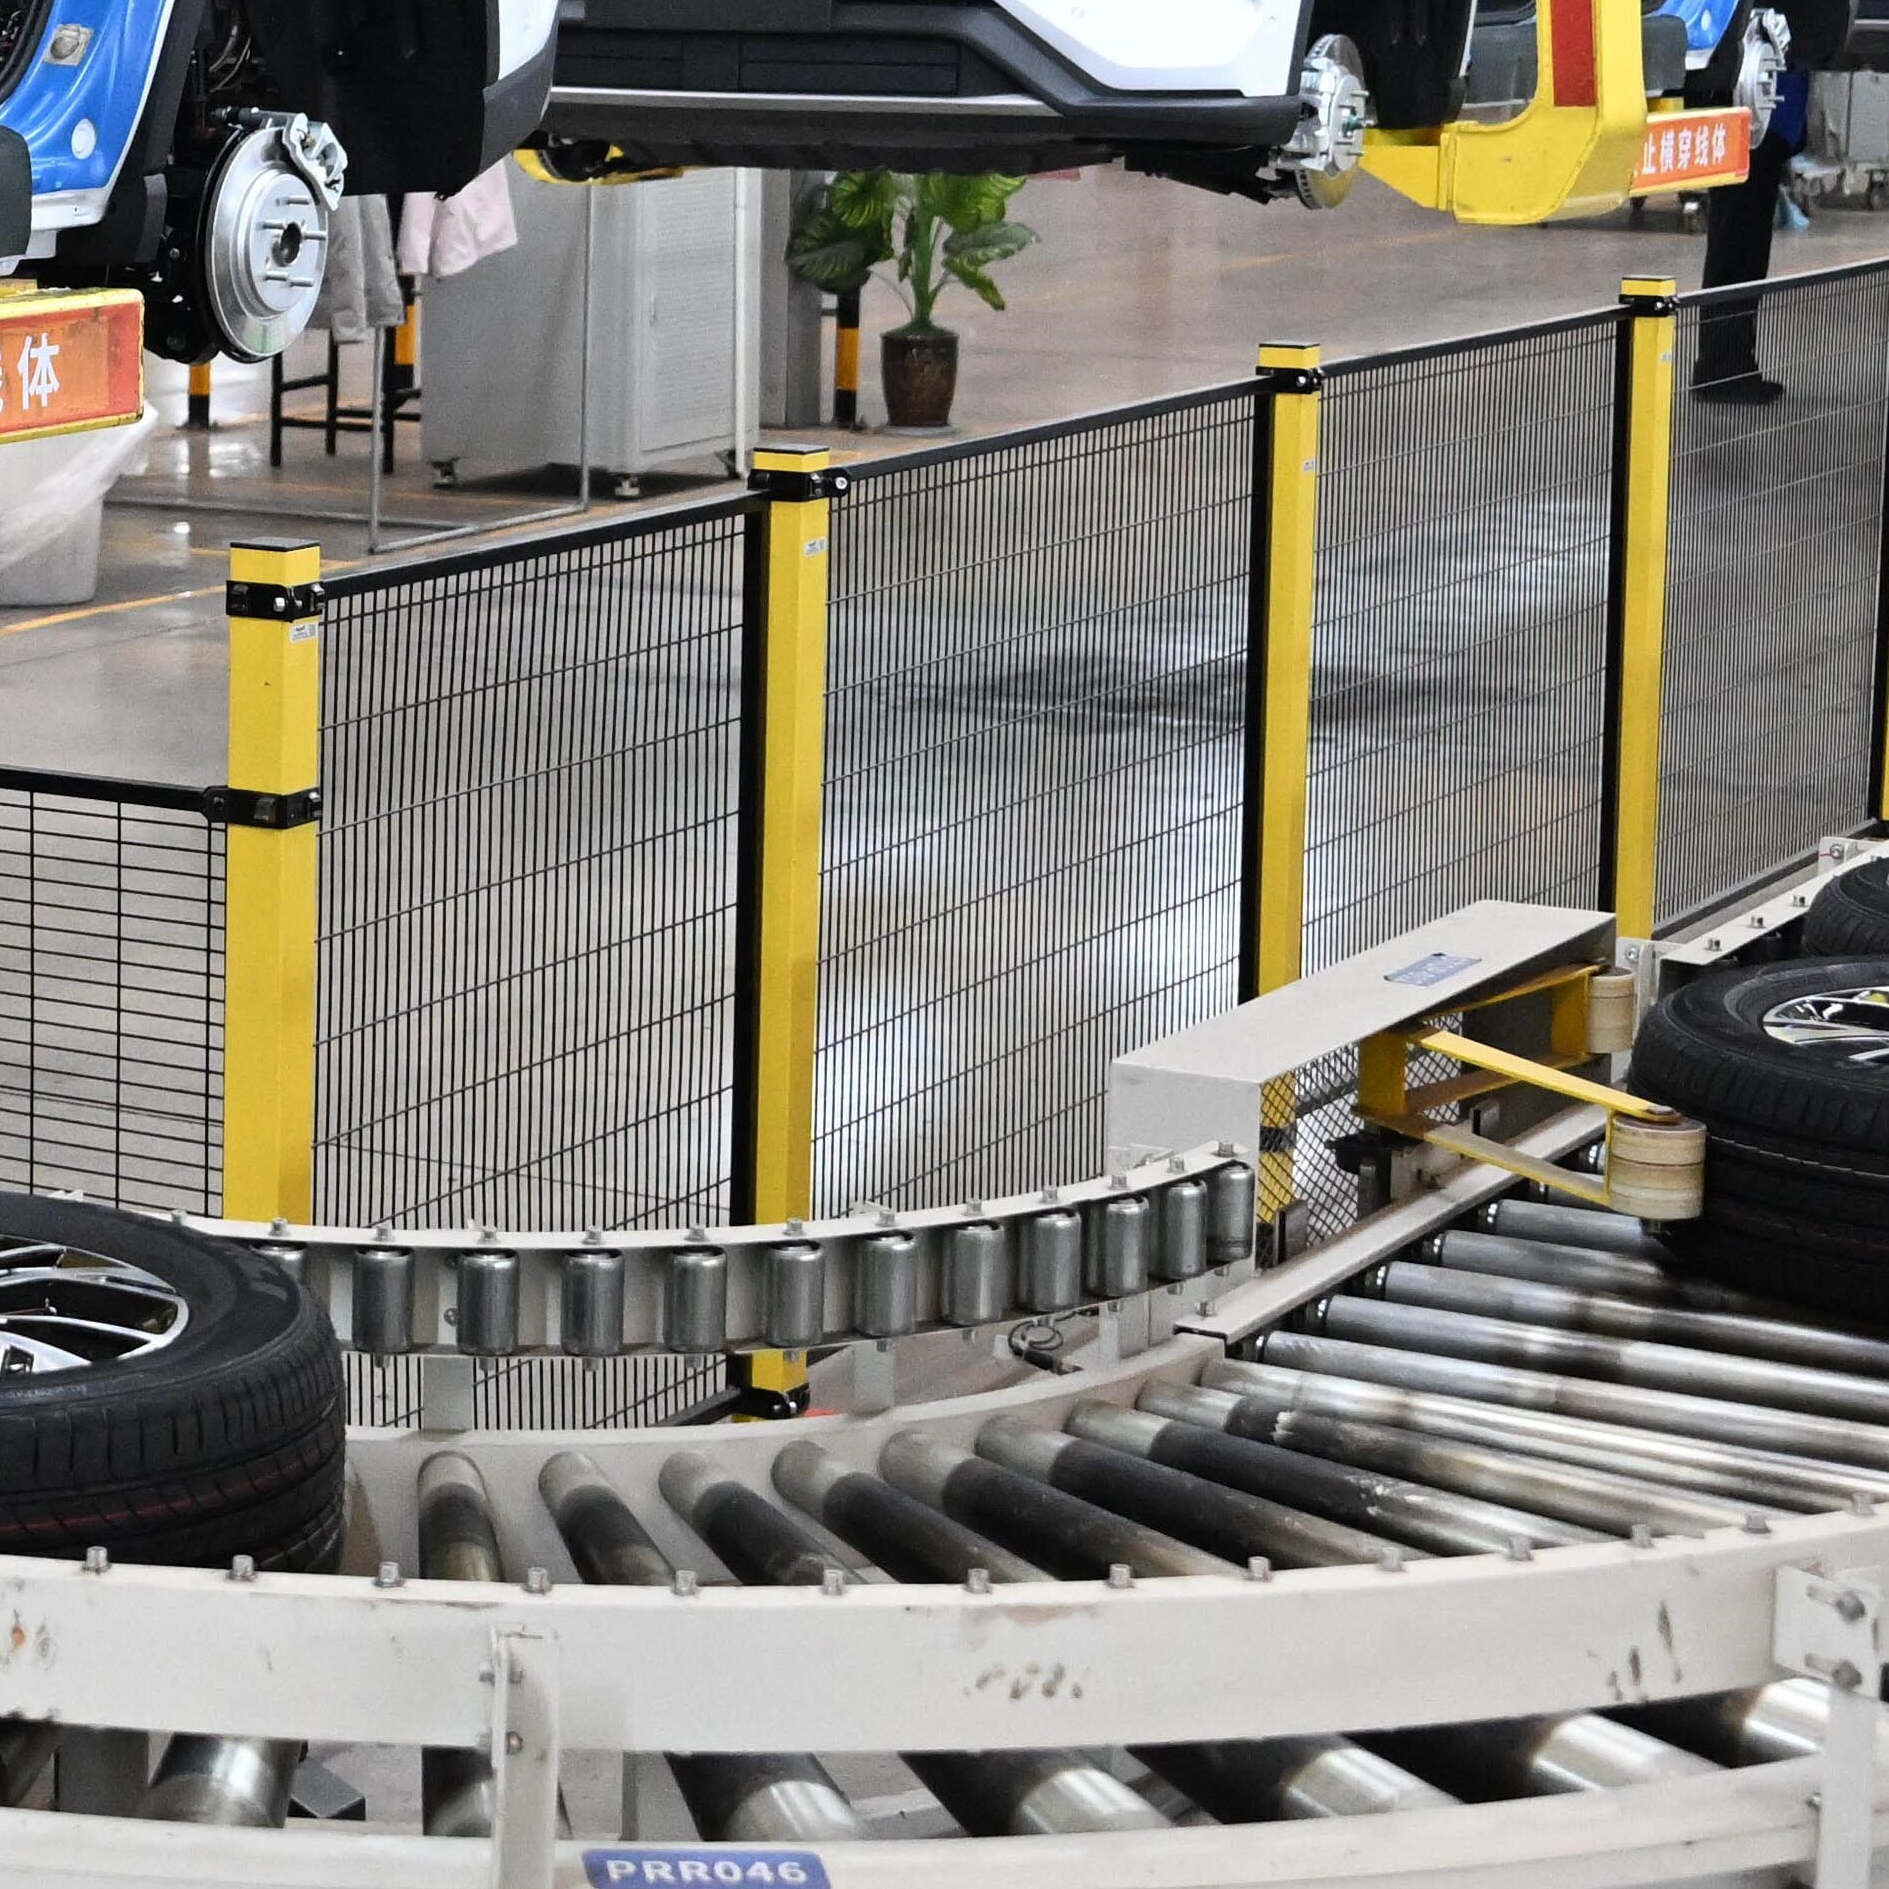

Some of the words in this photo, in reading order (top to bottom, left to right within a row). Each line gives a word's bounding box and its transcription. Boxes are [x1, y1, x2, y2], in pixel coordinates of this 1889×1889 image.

[1633, 121, 1726, 175] 止横穿线体
[606, 1860, 807, 1884] PRR046
